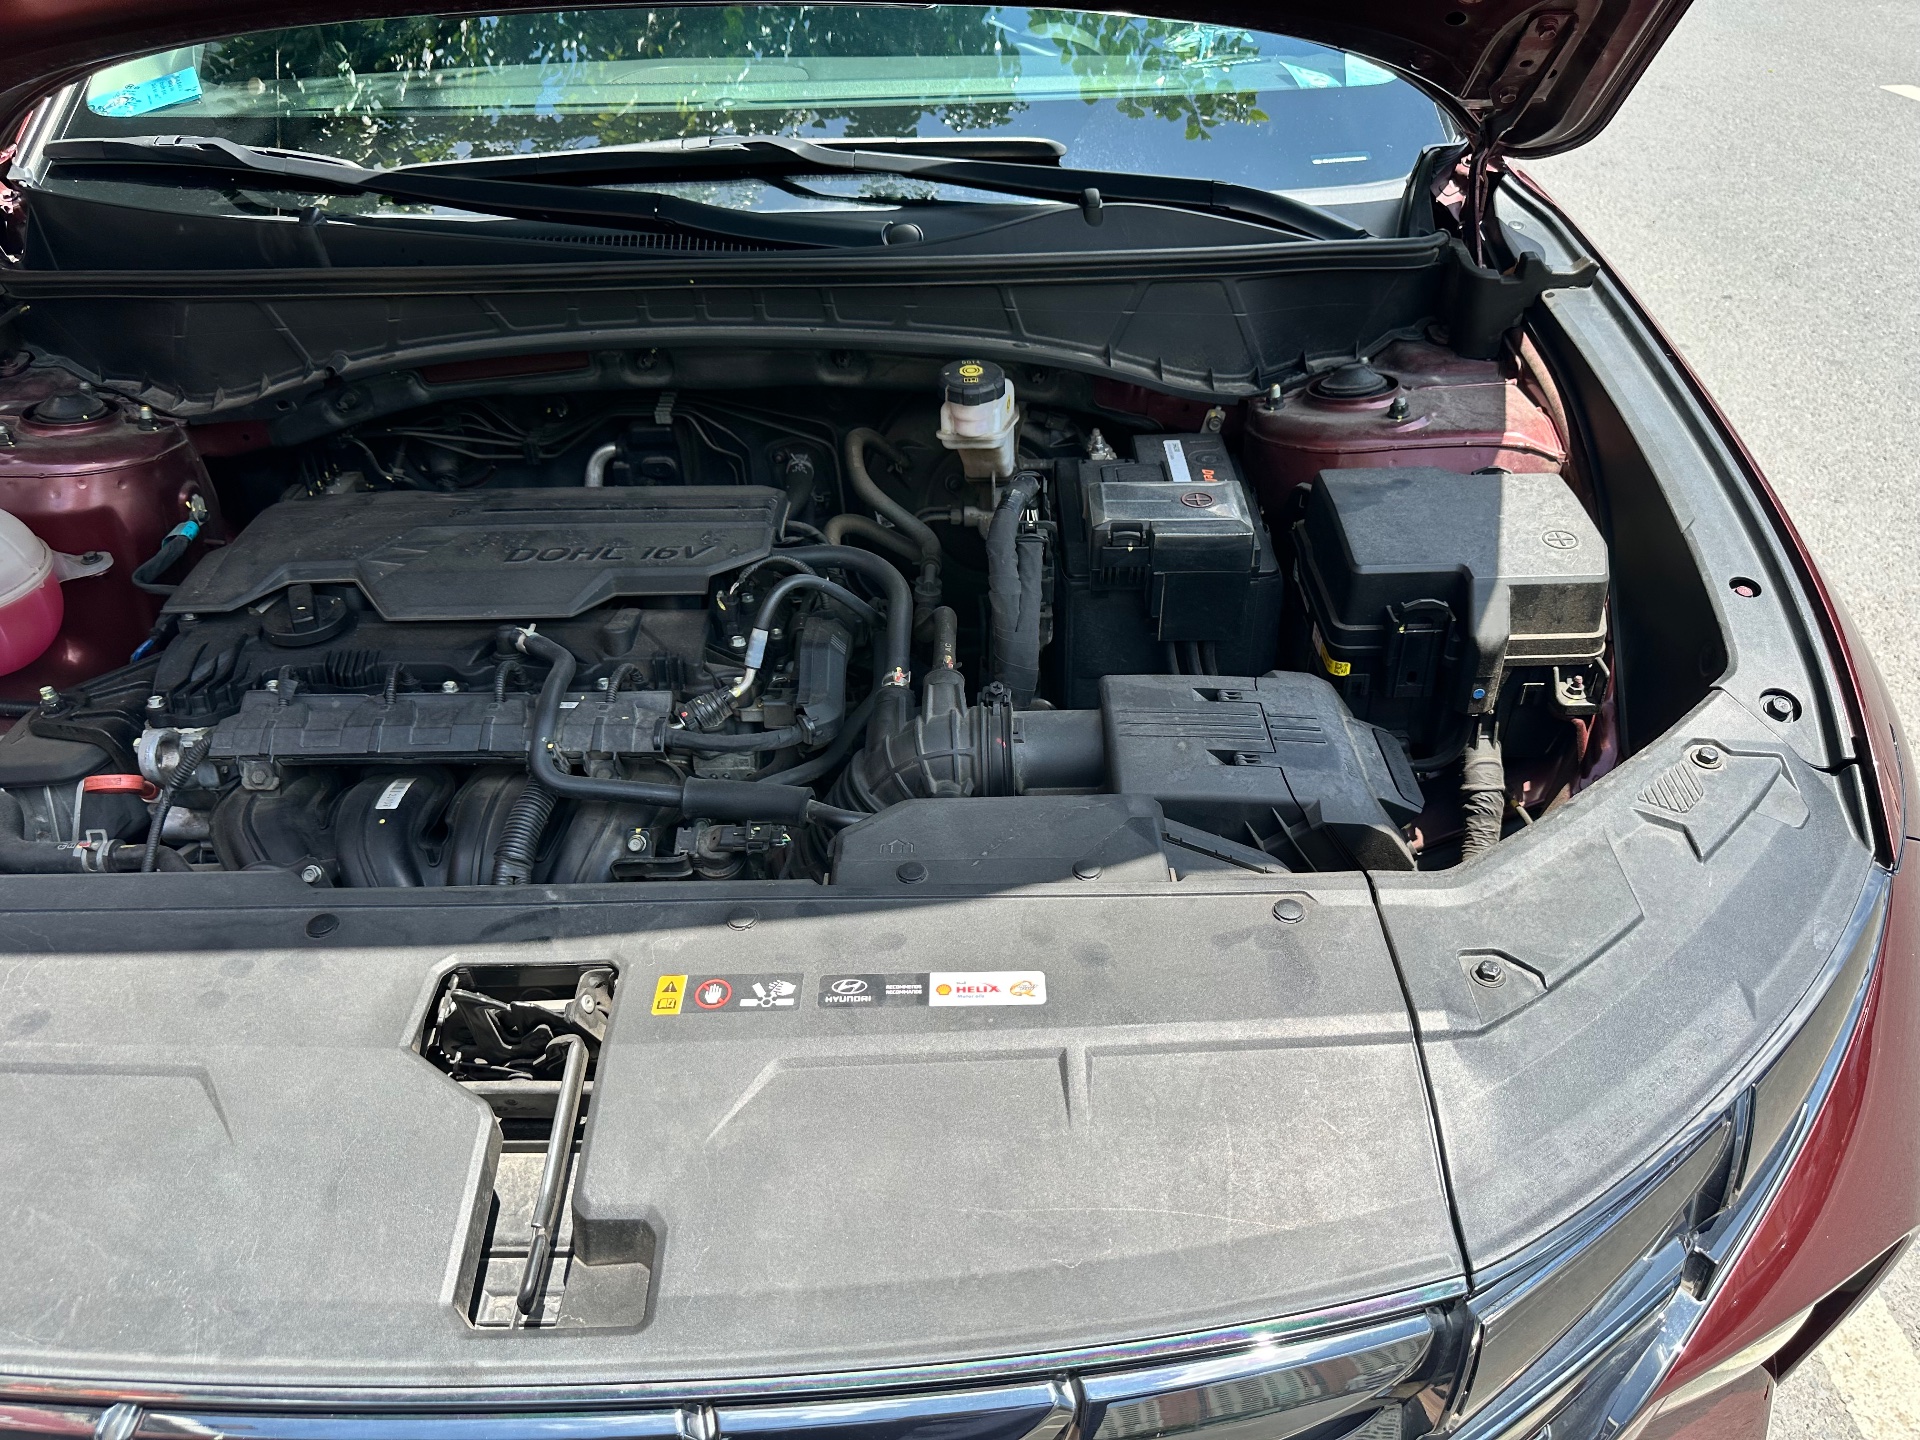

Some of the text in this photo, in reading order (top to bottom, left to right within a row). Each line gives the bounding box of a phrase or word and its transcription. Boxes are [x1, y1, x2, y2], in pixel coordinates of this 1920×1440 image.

[503, 545, 718, 563] DOHC 16V
[956, 983, 1002, 993] HELIX
[824, 995, 872, 1003] HYUNDAI
